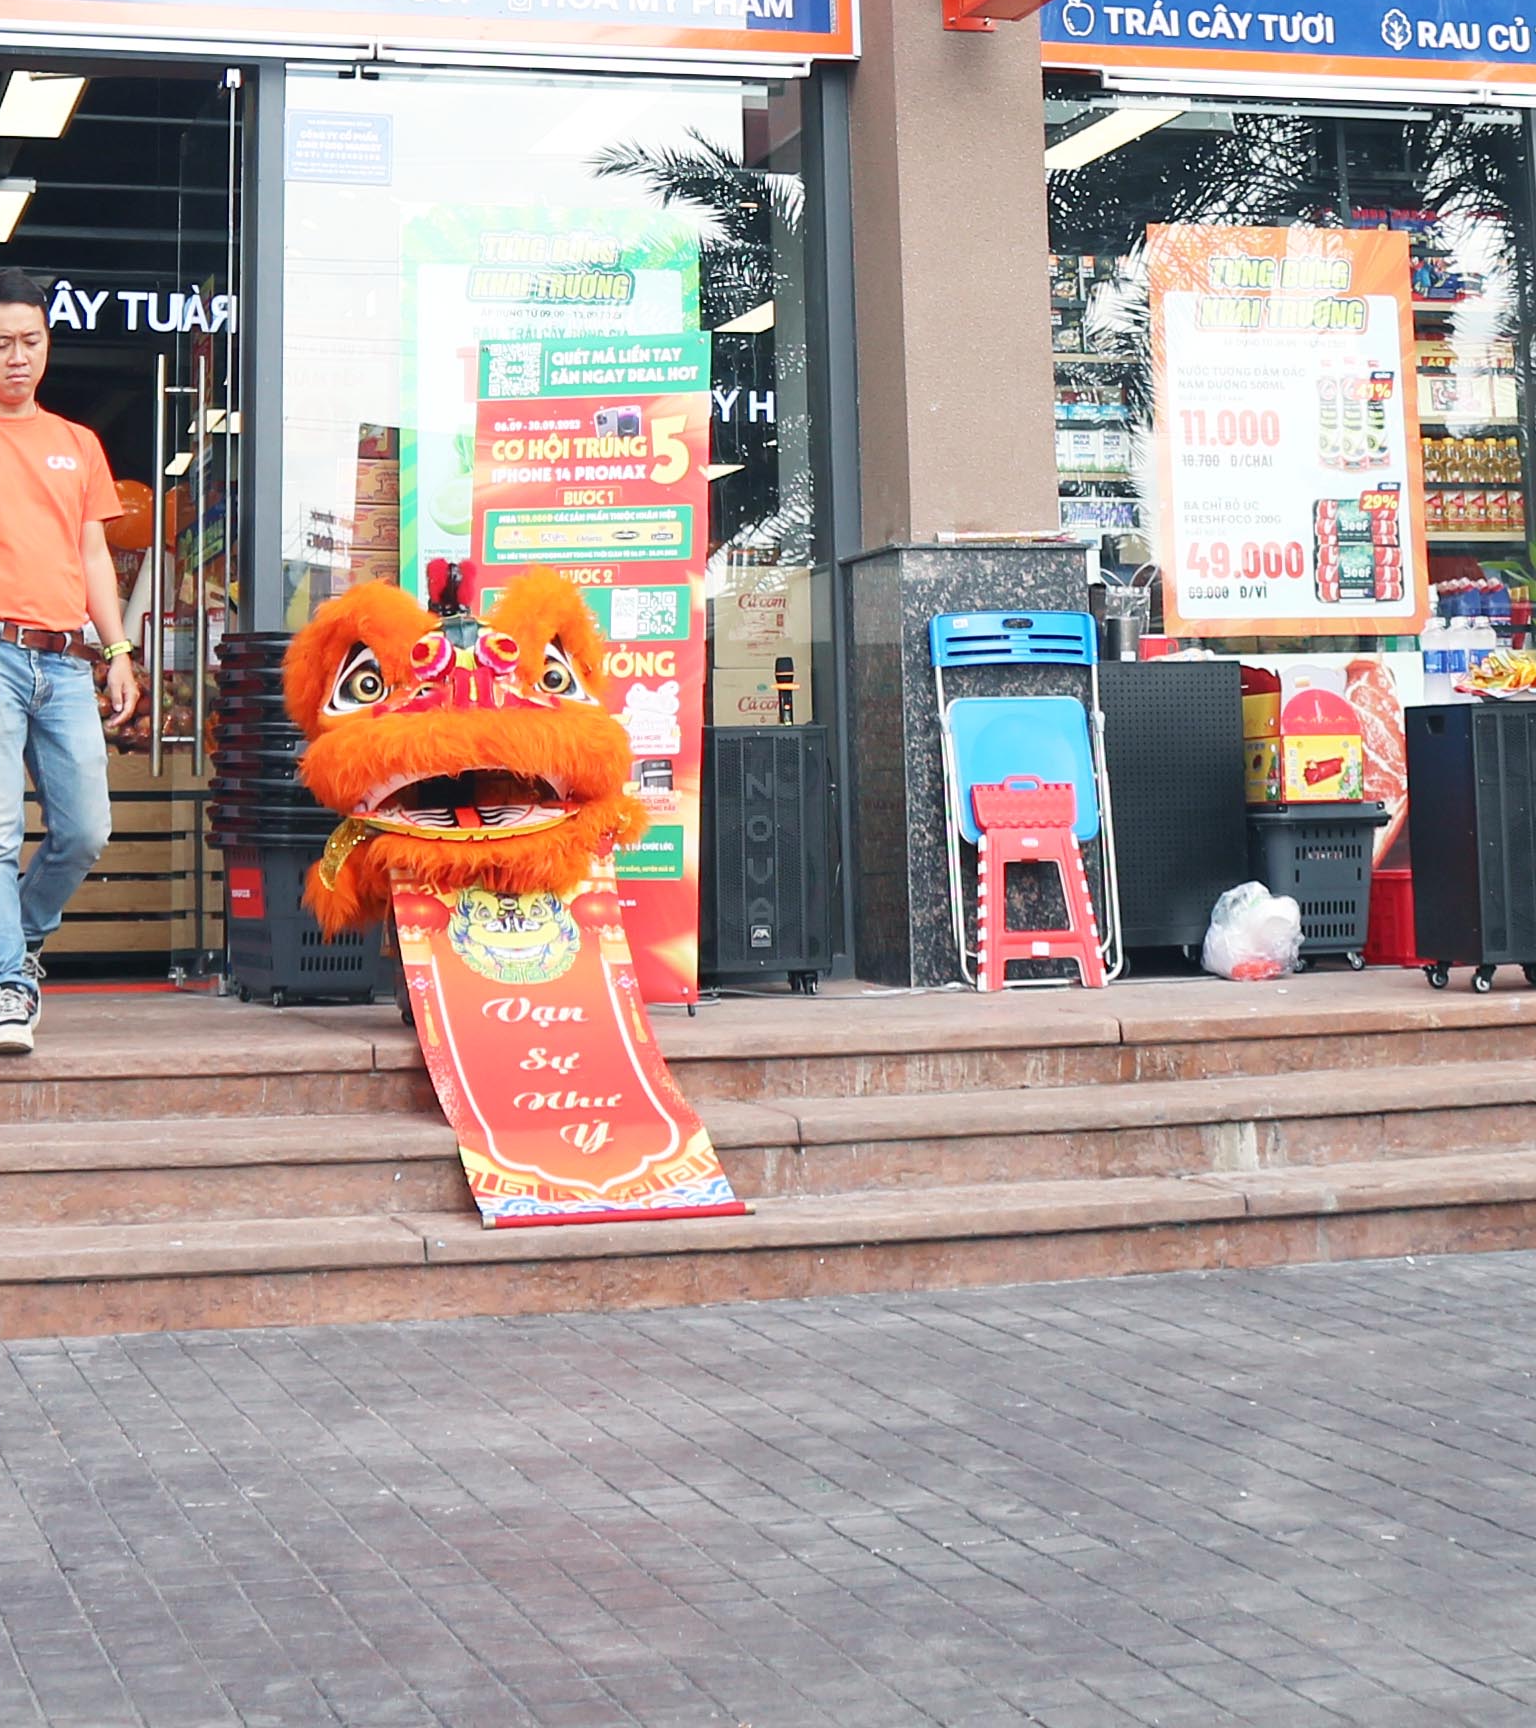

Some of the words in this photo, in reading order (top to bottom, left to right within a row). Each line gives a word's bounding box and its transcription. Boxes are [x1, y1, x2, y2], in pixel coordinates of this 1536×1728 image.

[1104, 0, 1180, 36] TRÁI
[1187, 1, 1258, 40] CÂY
[1263, 10, 1335, 44] TƯƠI
[1417, 20, 1480, 51] RAU
[1487, 14, 1531, 53] CỦ
[43, 281, 110, 330] ÂY
[1199, 297, 1261, 328] KHAI
[1266, 294, 1365, 330] TRƯƠNG
[551, 347, 590, 367] QUÉT
[592, 347, 616, 364] MÃ
[653, 348, 683, 363] TAY
[551, 368, 580, 385] SĂN
[582, 368, 626, 384] NGAY
[627, 367, 665, 383] DEAL
[667, 365, 699, 381] HOT
[1179, 409, 1281, 447] 11.000
[491, 438, 525, 462] CƠ
[528, 432, 570, 464] HỘI
[573, 431, 648, 459] TRÚNG
[650, 415, 690, 485] 5
[492, 467, 552, 484] IPHONE
[554, 467, 572, 482] 14
[574, 463, 647, 482] PROMAX
[607, 490, 614, 505] 1
[1363, 493, 1398, 510] 29%
[1186, 541, 1305, 580] 49.000
[481, 996, 590, 1029] Vạn
[519, 1046, 581, 1075] Sự
[512, 1090, 624, 1111] Như
